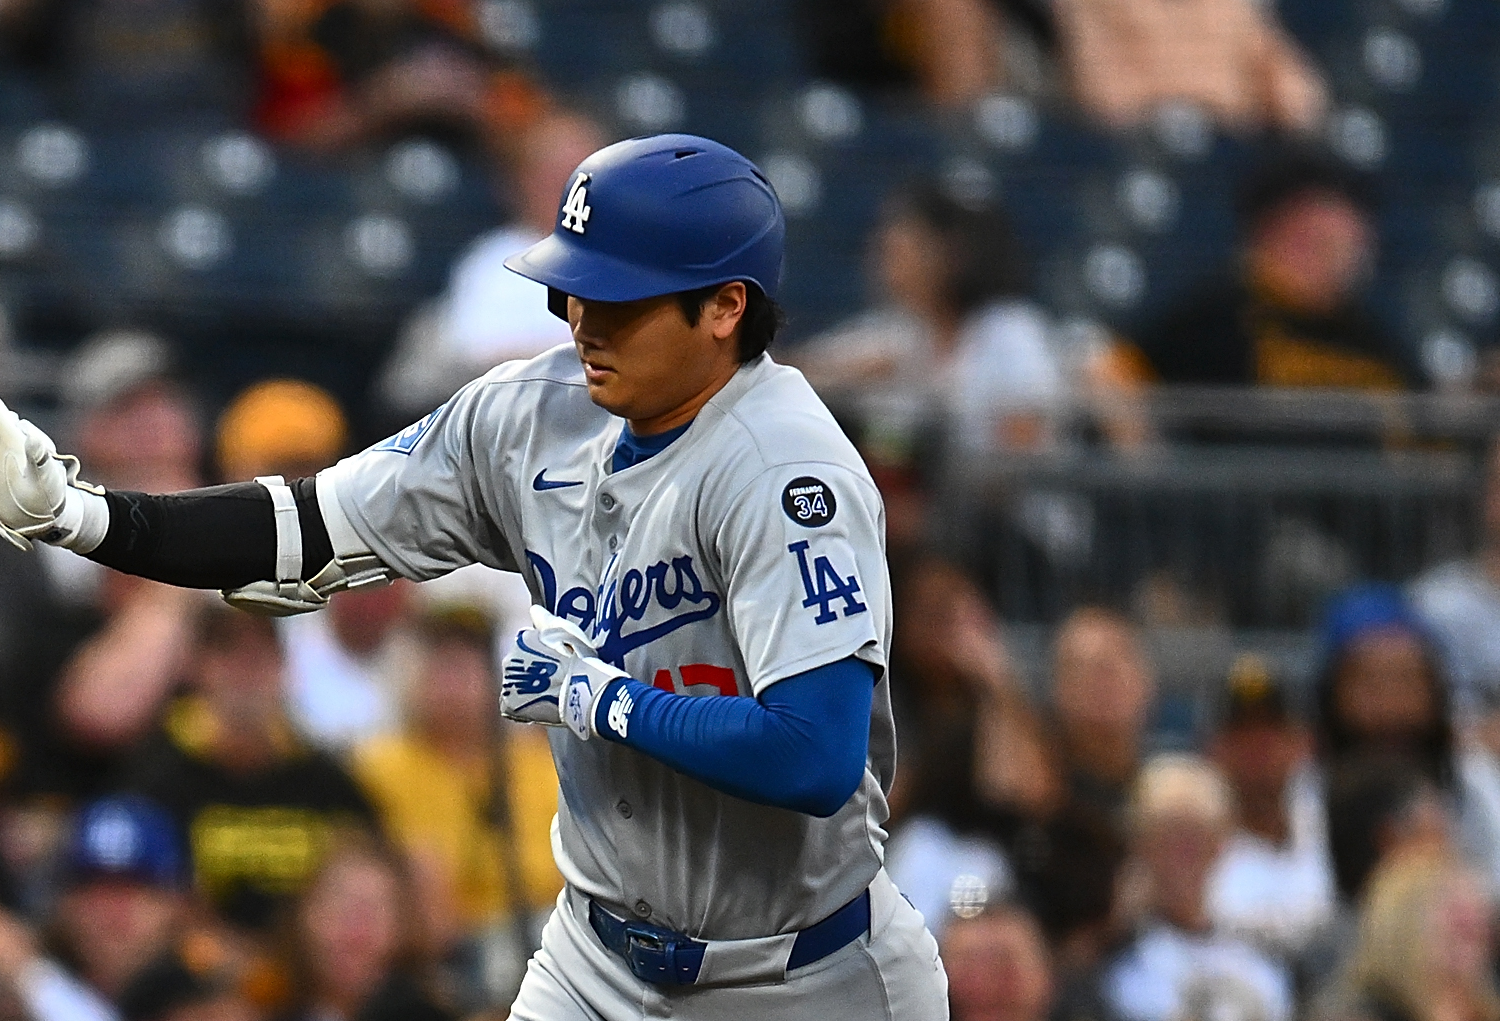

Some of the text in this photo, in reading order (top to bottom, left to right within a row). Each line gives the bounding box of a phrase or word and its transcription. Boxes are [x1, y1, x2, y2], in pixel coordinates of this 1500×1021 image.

[561, 171, 591, 234] LA
[793, 493, 828, 519] 34
[524, 548, 721, 672] Dogers
[787, 539, 867, 625] LA
